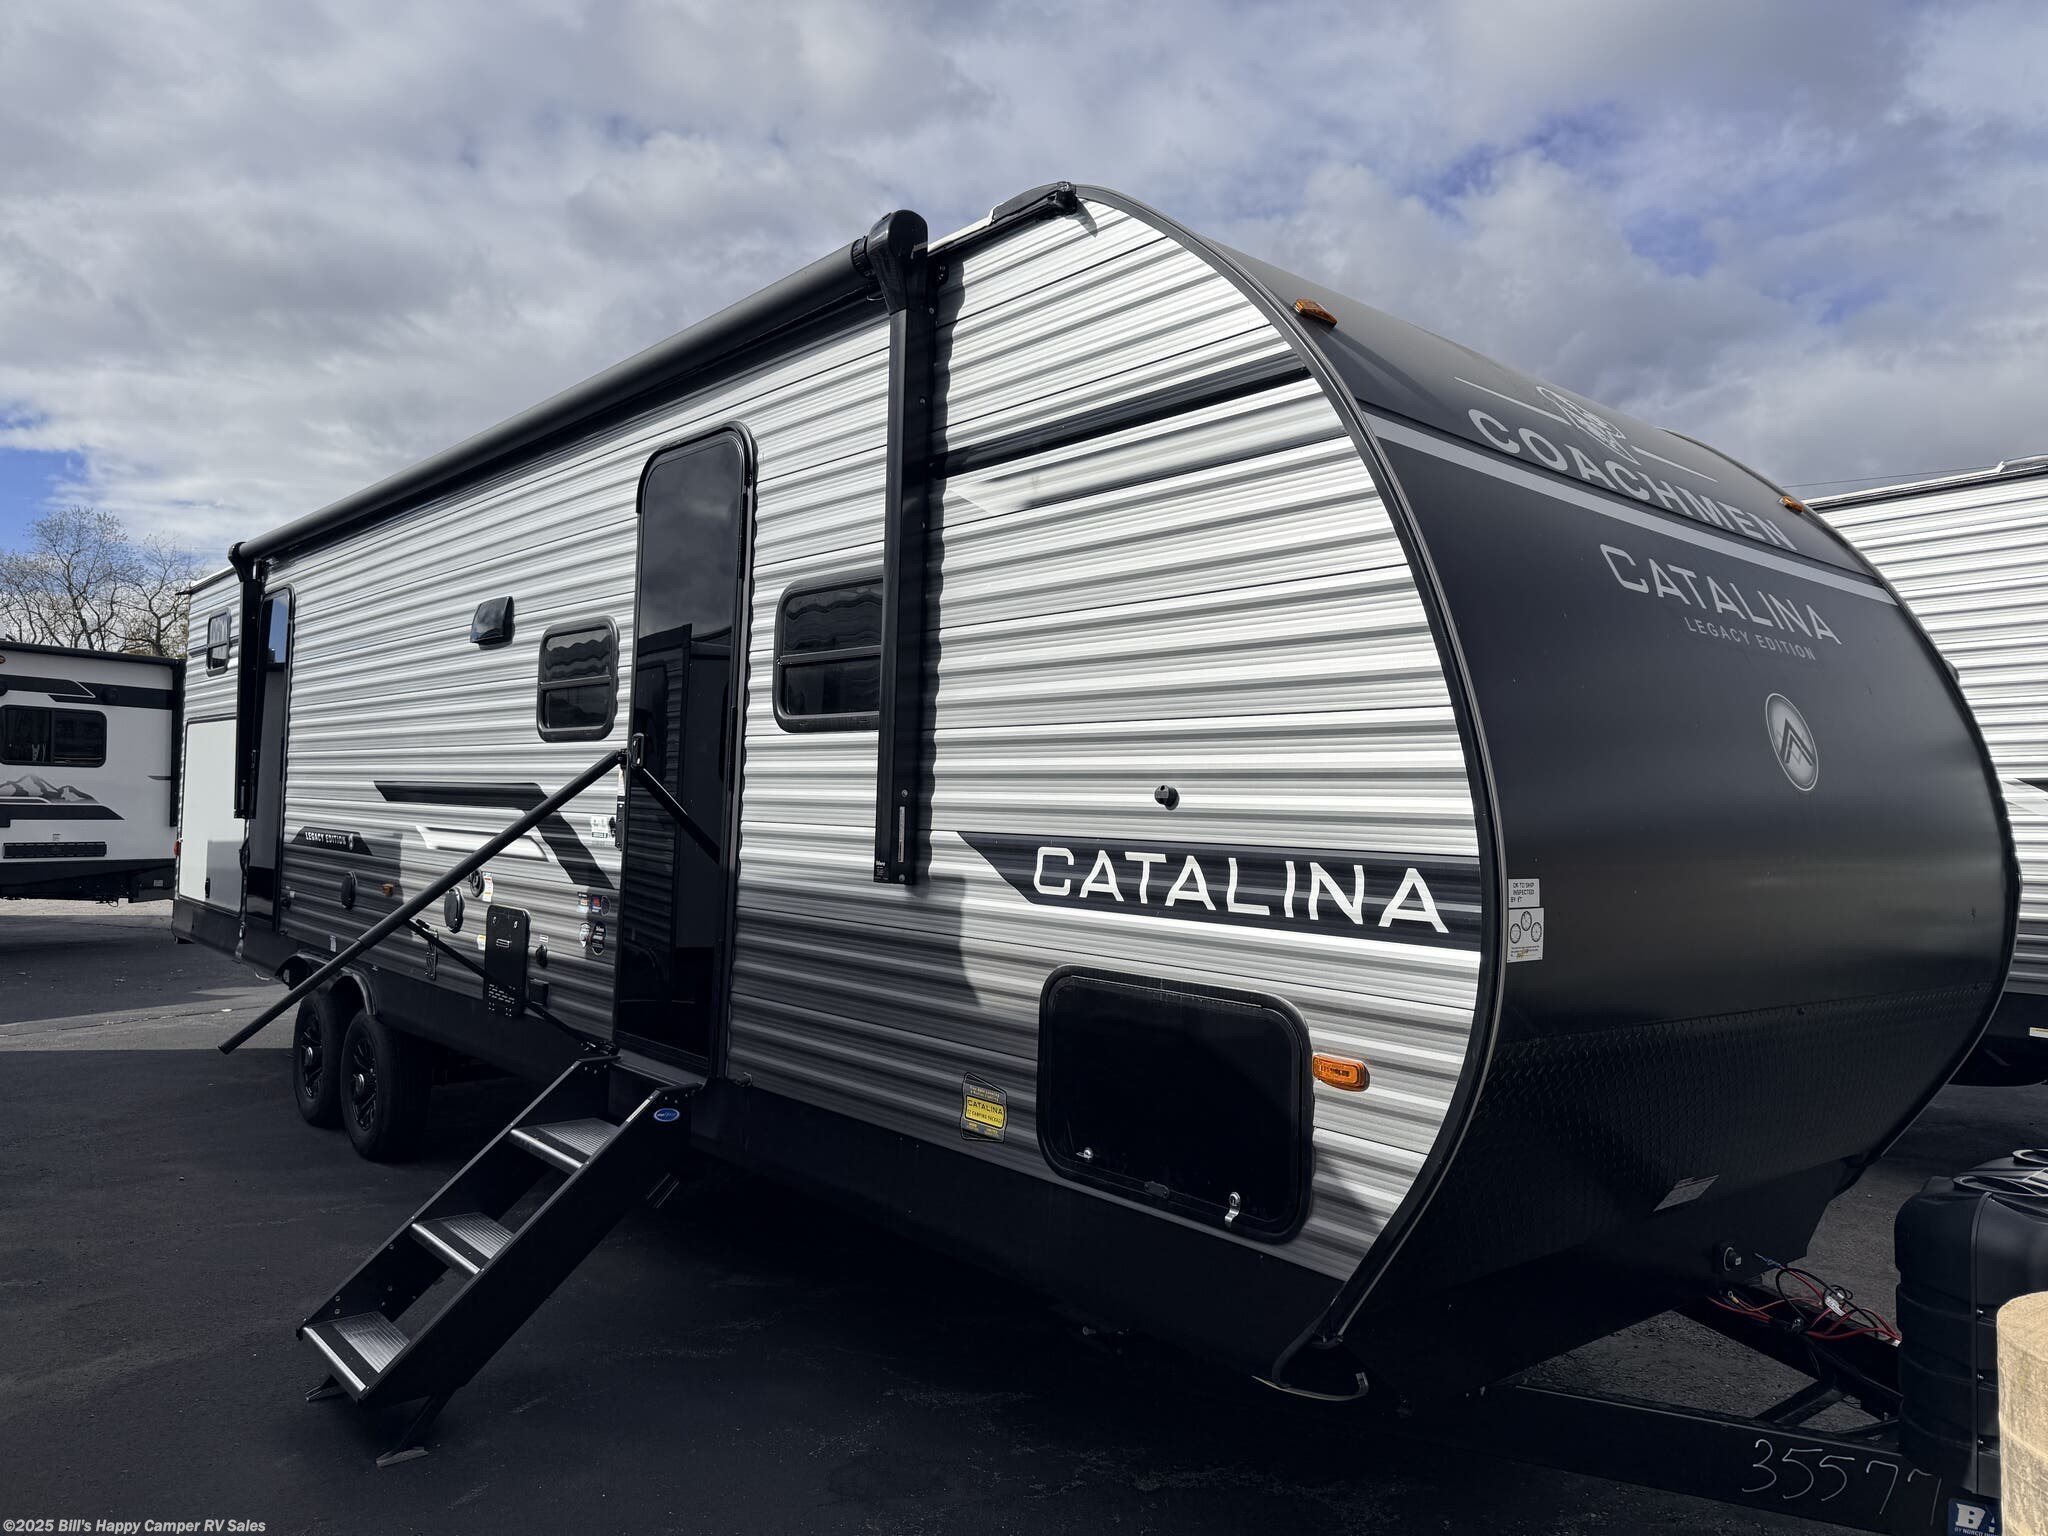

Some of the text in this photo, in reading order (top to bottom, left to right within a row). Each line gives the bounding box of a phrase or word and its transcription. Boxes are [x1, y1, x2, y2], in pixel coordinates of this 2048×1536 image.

[1468, 408, 1798, 551] COACHMEN
[1600, 544, 1842, 646] CATALINA
[1684, 616, 1816, 661] LEGACY EDITION
[305, 831, 347, 845] LEGACY EDITION
[1033, 846, 1450, 934] CATALINA
[967, 1100, 1003, 1115] CATALINA
[1741, 1439, 1942, 1526] 35577
